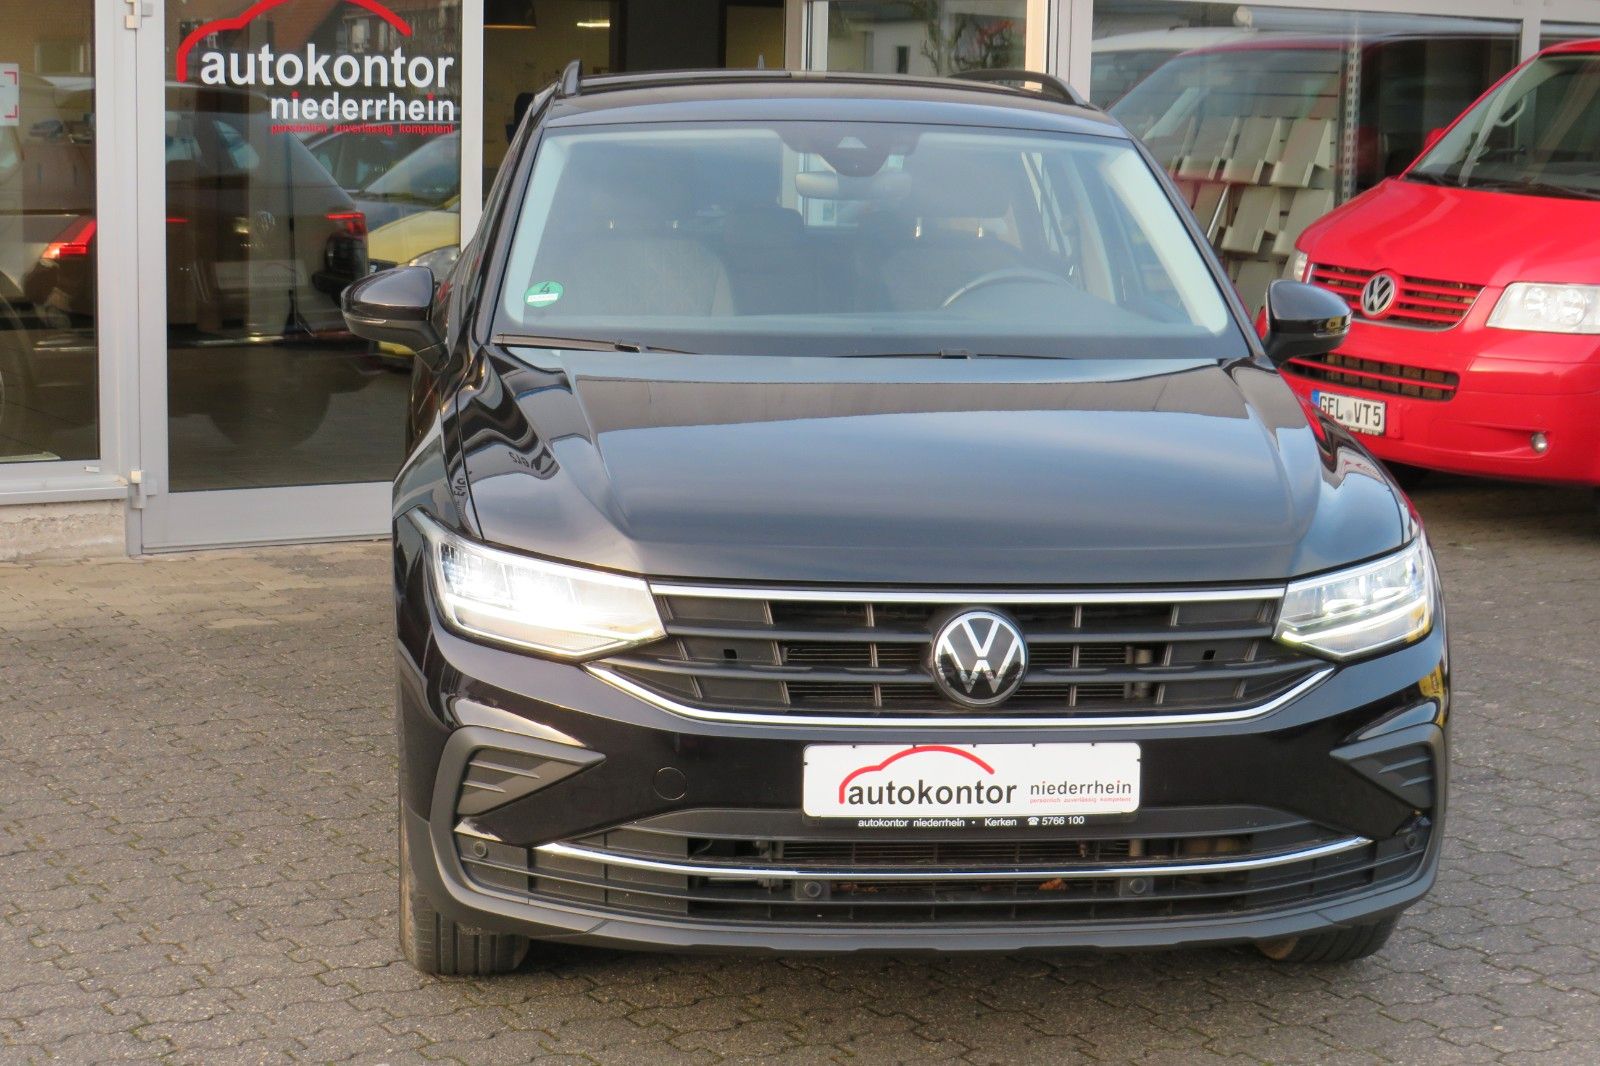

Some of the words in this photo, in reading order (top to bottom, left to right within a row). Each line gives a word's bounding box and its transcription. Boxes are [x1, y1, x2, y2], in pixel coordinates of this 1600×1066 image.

[201, 43, 454, 87] autokontor
[271, 91, 454, 121] niederrhein
[848, 779, 1017, 805] autokontor
[1030, 780, 1132, 795] niederrhein
[858, 818, 909, 827] autokontor
[913, 818, 965, 827] niederrhein
[984, 817, 1017, 826] Kerken
[1041, 816, 1065, 825] 5766
[1068, 816, 1085, 825] 100
